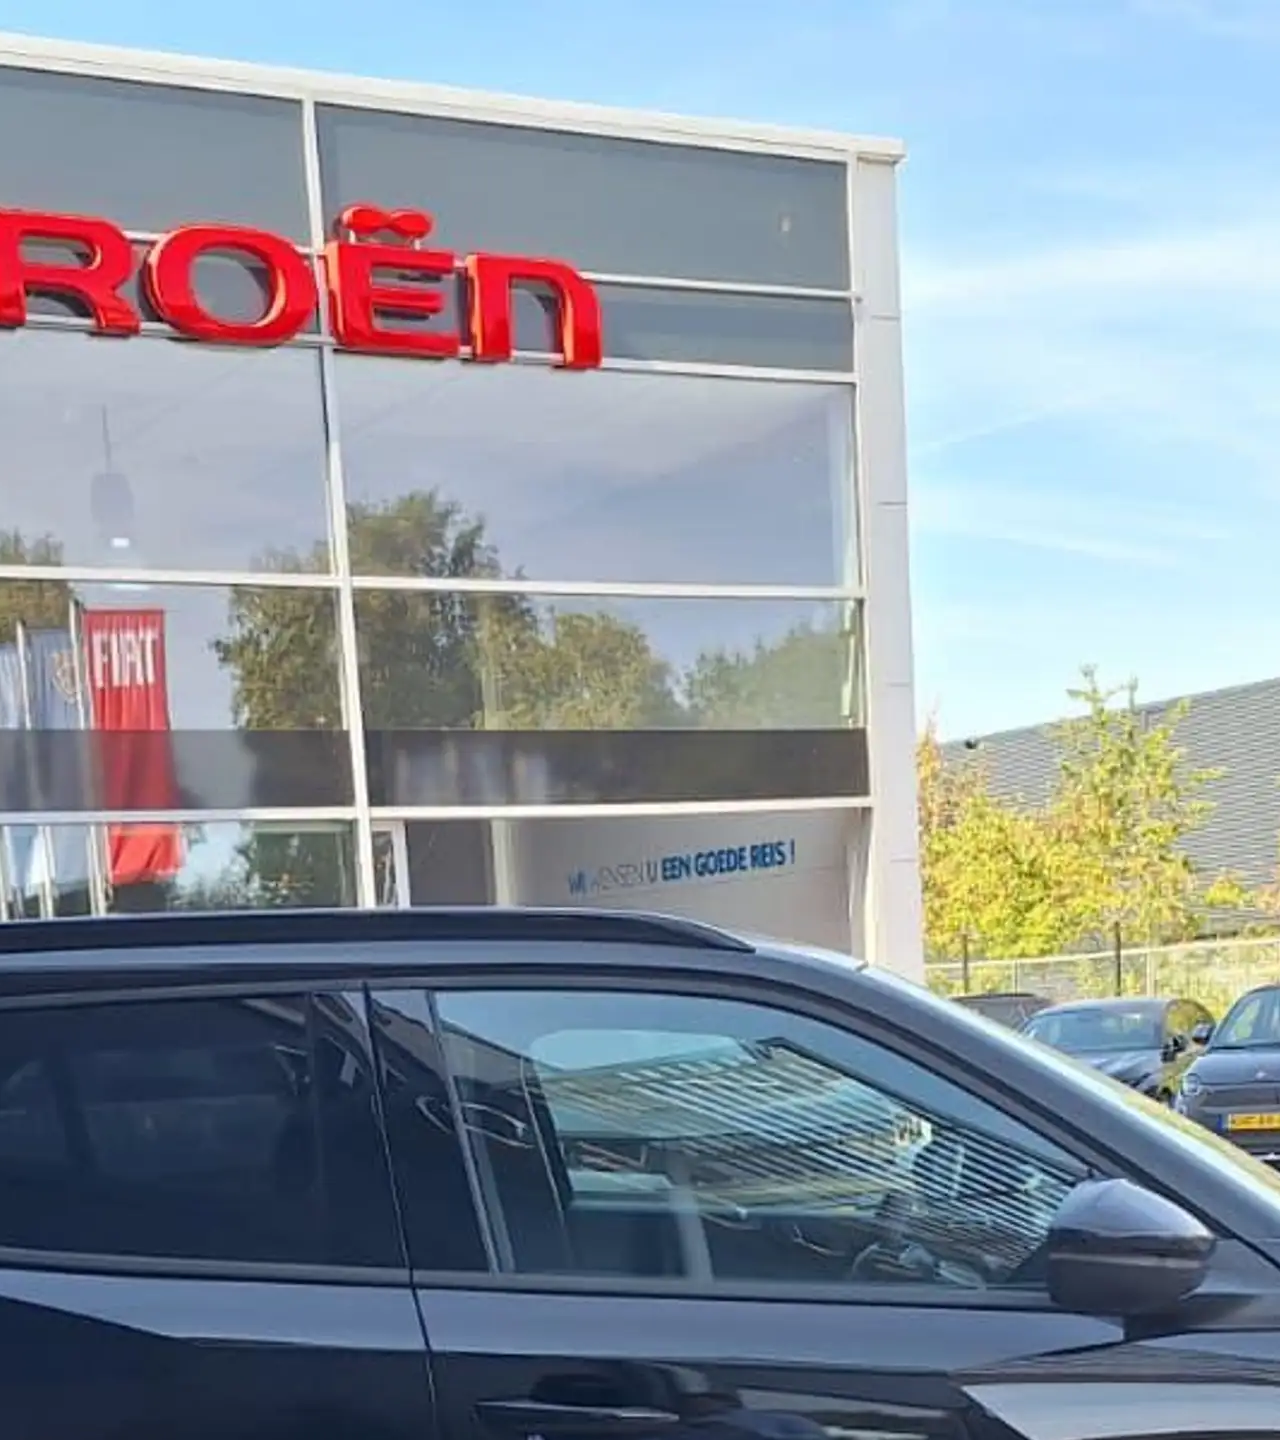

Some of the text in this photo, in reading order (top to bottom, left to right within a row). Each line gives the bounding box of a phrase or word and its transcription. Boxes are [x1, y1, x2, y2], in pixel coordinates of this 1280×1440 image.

[92, 627, 160, 688] FIAT
[661, 855, 692, 881] EEN
[694, 846, 748, 877] GOEDE
[749, 840, 787, 868] REIS
